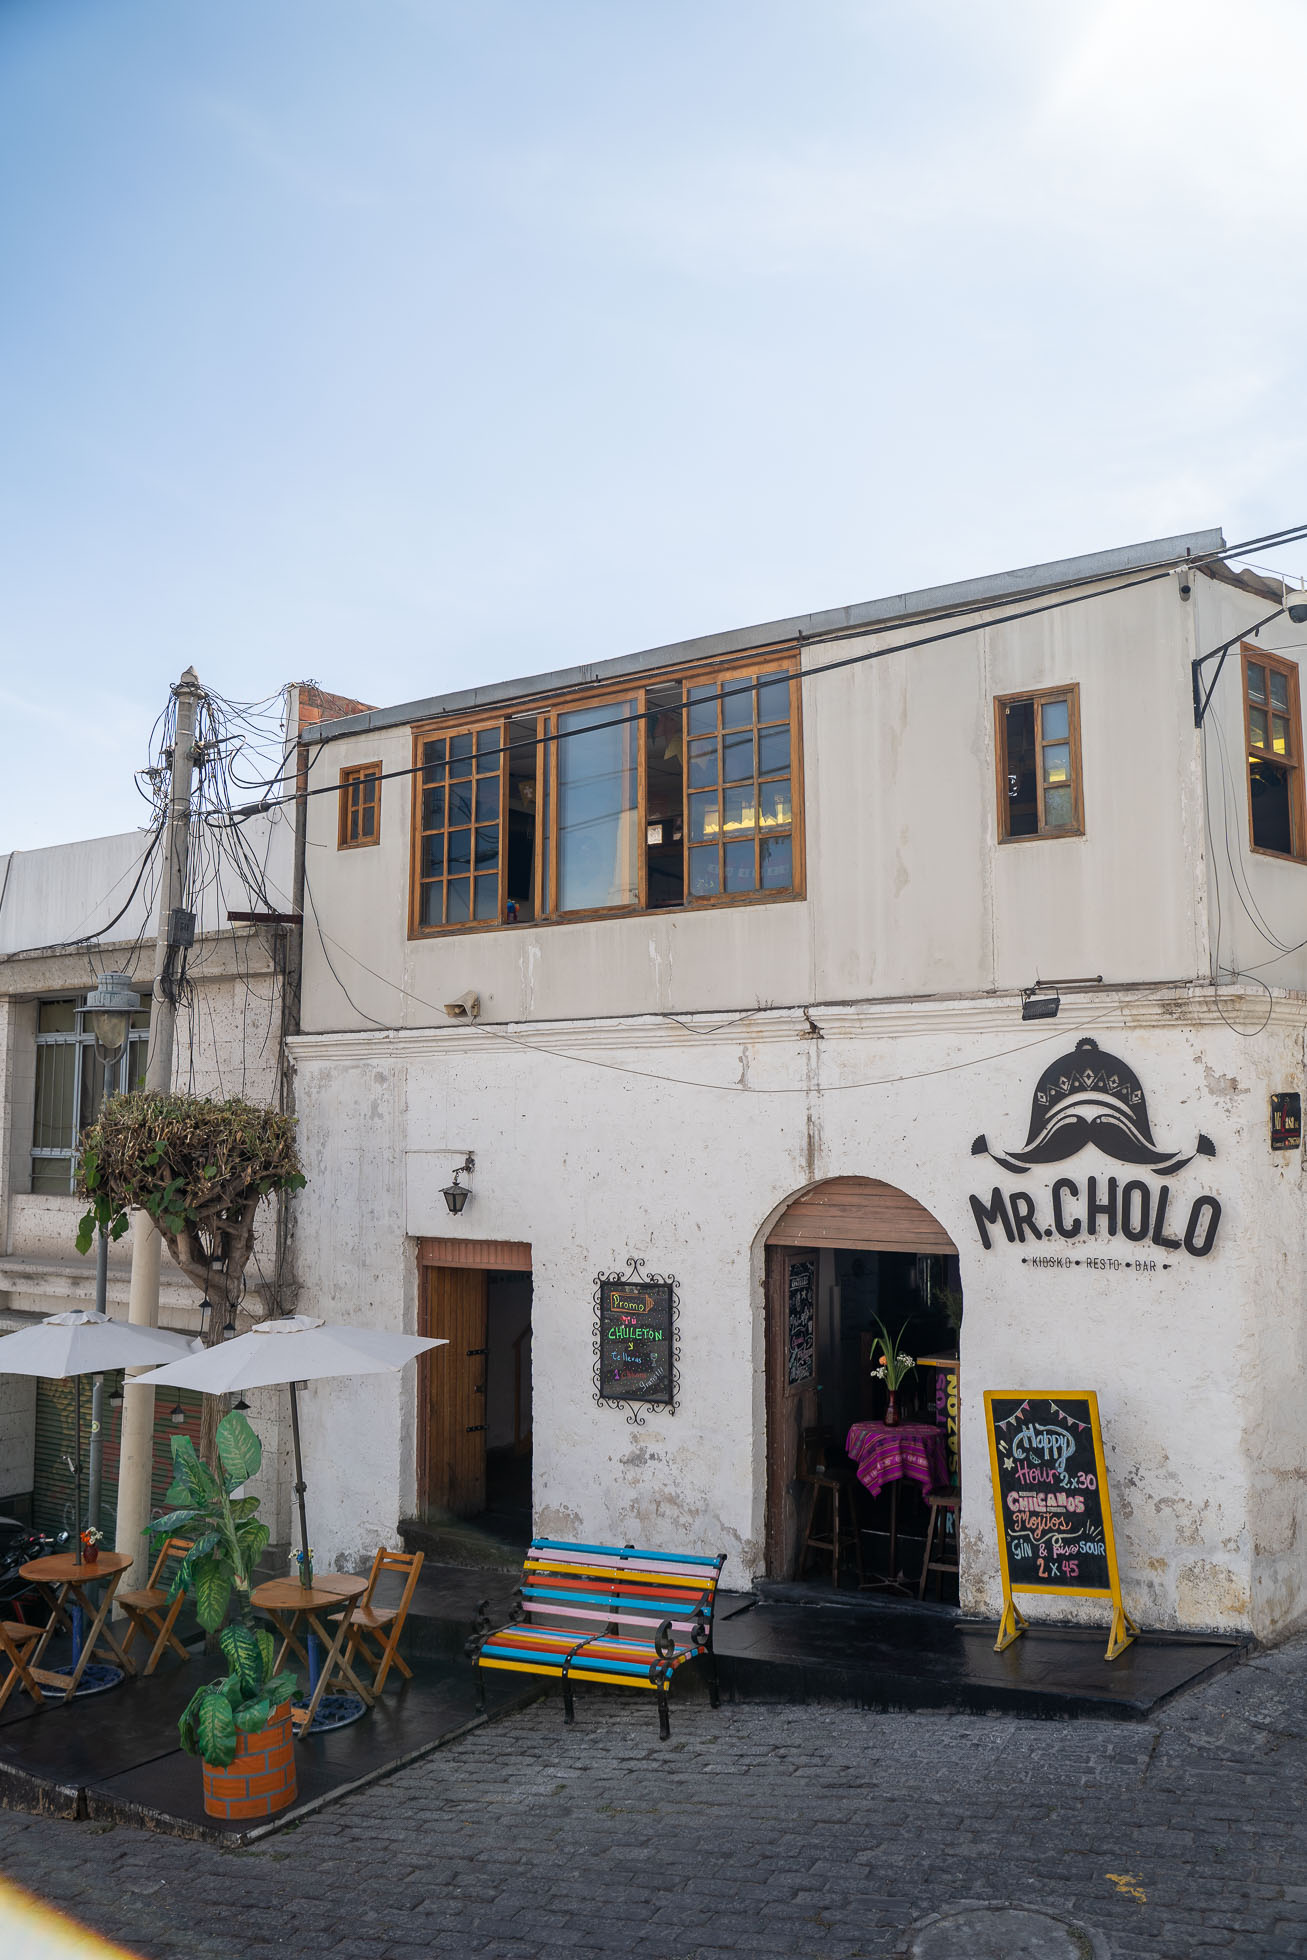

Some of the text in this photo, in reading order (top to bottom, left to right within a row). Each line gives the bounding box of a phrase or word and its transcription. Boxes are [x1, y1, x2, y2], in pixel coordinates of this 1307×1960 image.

[1032, 1256, 1156, 1272] KIOSKO RESTO BAR
[613, 1294, 645, 1312] Promo
[608, 1327, 662, 1341] CHULETON
[1013, 1423, 1075, 1472] Happy
[1016, 1461, 1059, 1485] Hour
[1013, 1512, 1072, 1538] Mojitos
[1039, 1544, 1048, 1557] &
[1080, 1541, 1105, 1556] SOUR
[1062, 1560, 1079, 1577] 45
